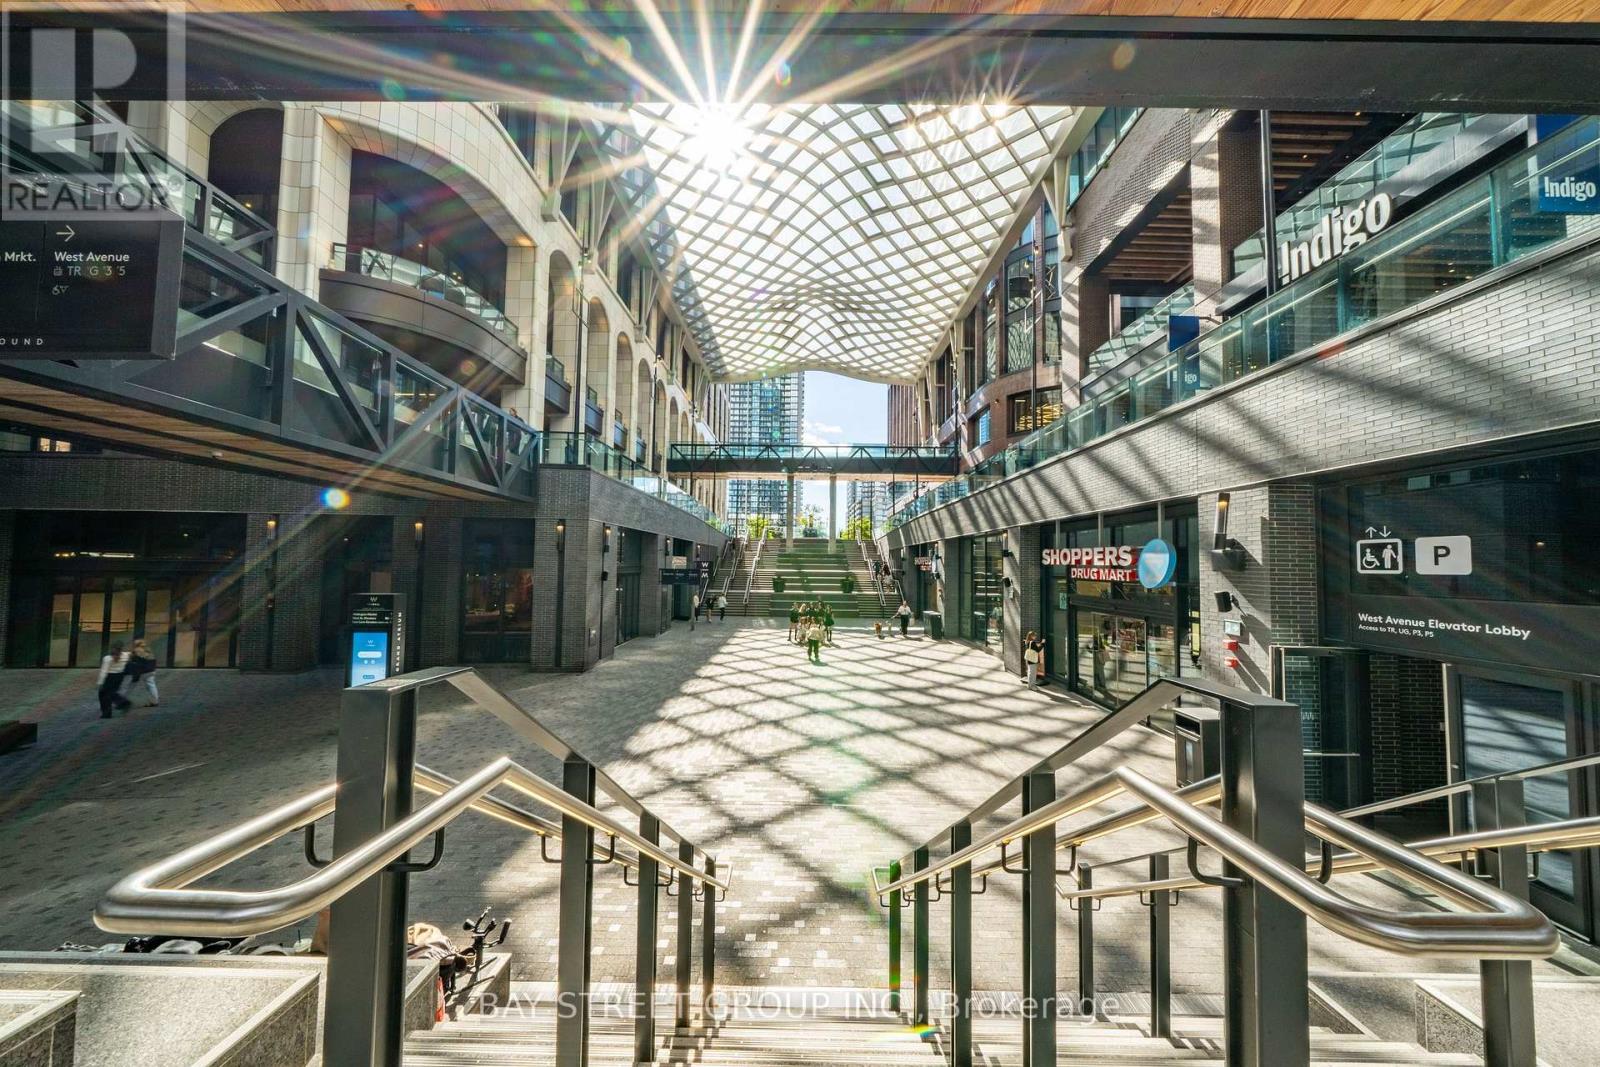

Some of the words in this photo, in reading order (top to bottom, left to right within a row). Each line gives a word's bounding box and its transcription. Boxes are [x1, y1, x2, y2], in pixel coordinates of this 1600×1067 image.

[1544, 176, 1597, 202] Indigo
[1280, 192, 1392, 286] Indigo
[4, 251, 37, 262] Mrkt.
[54, 251, 83, 262] West
[86, 251, 130, 262] Avenue
[68, 265, 82, 276] TR
[1041, 545, 1133, 567] SHOPPERS
[1433, 545, 1451, 566] P
[1071, 567, 1098, 580] DRUG
[1099, 568, 1132, 582] MART
[1358, 612, 1384, 624] West
[1385, 615, 1426, 628] Avenue
[1428, 619, 1482, 633] Elevator
[1485, 624, 1531, 641] Lobby
[1358, 624, 1379, 632] Access
